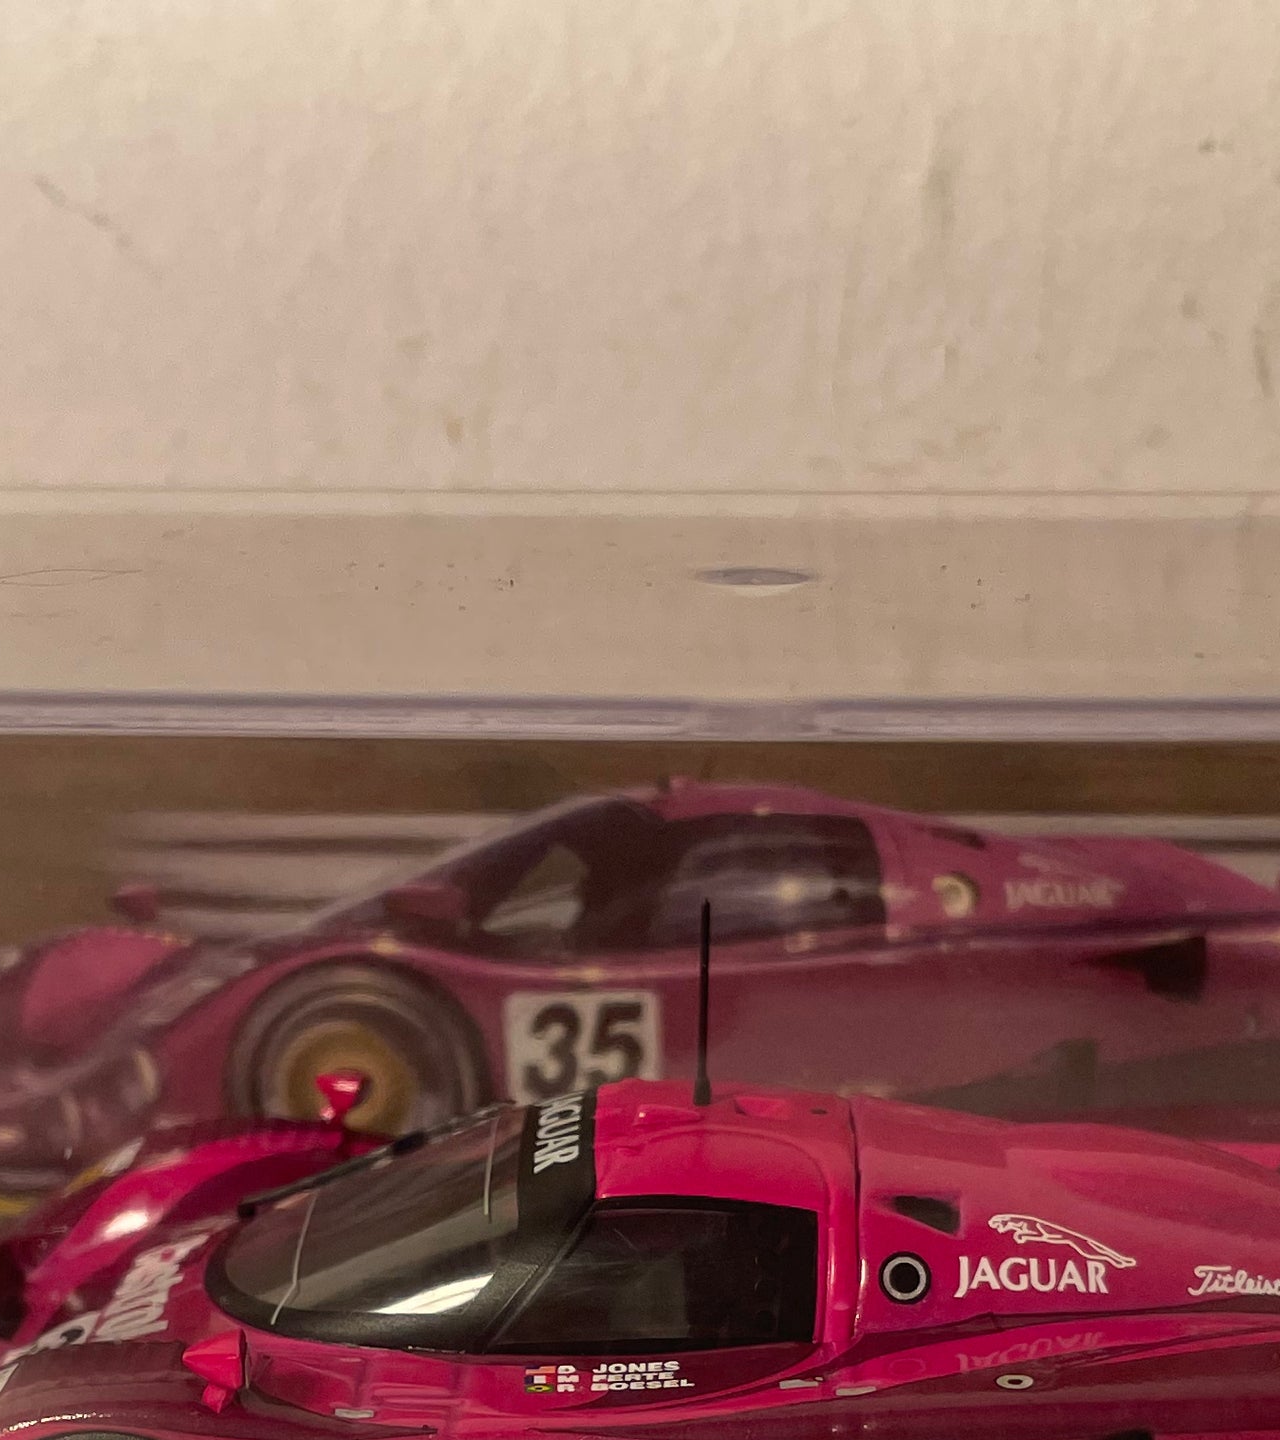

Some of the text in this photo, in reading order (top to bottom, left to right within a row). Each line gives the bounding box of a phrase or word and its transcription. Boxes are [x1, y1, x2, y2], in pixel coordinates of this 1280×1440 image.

[523, 1001, 644, 1098] 35
[953, 1255, 1110, 1299] JAGUAR
[591, 1360, 681, 1374] JONES
